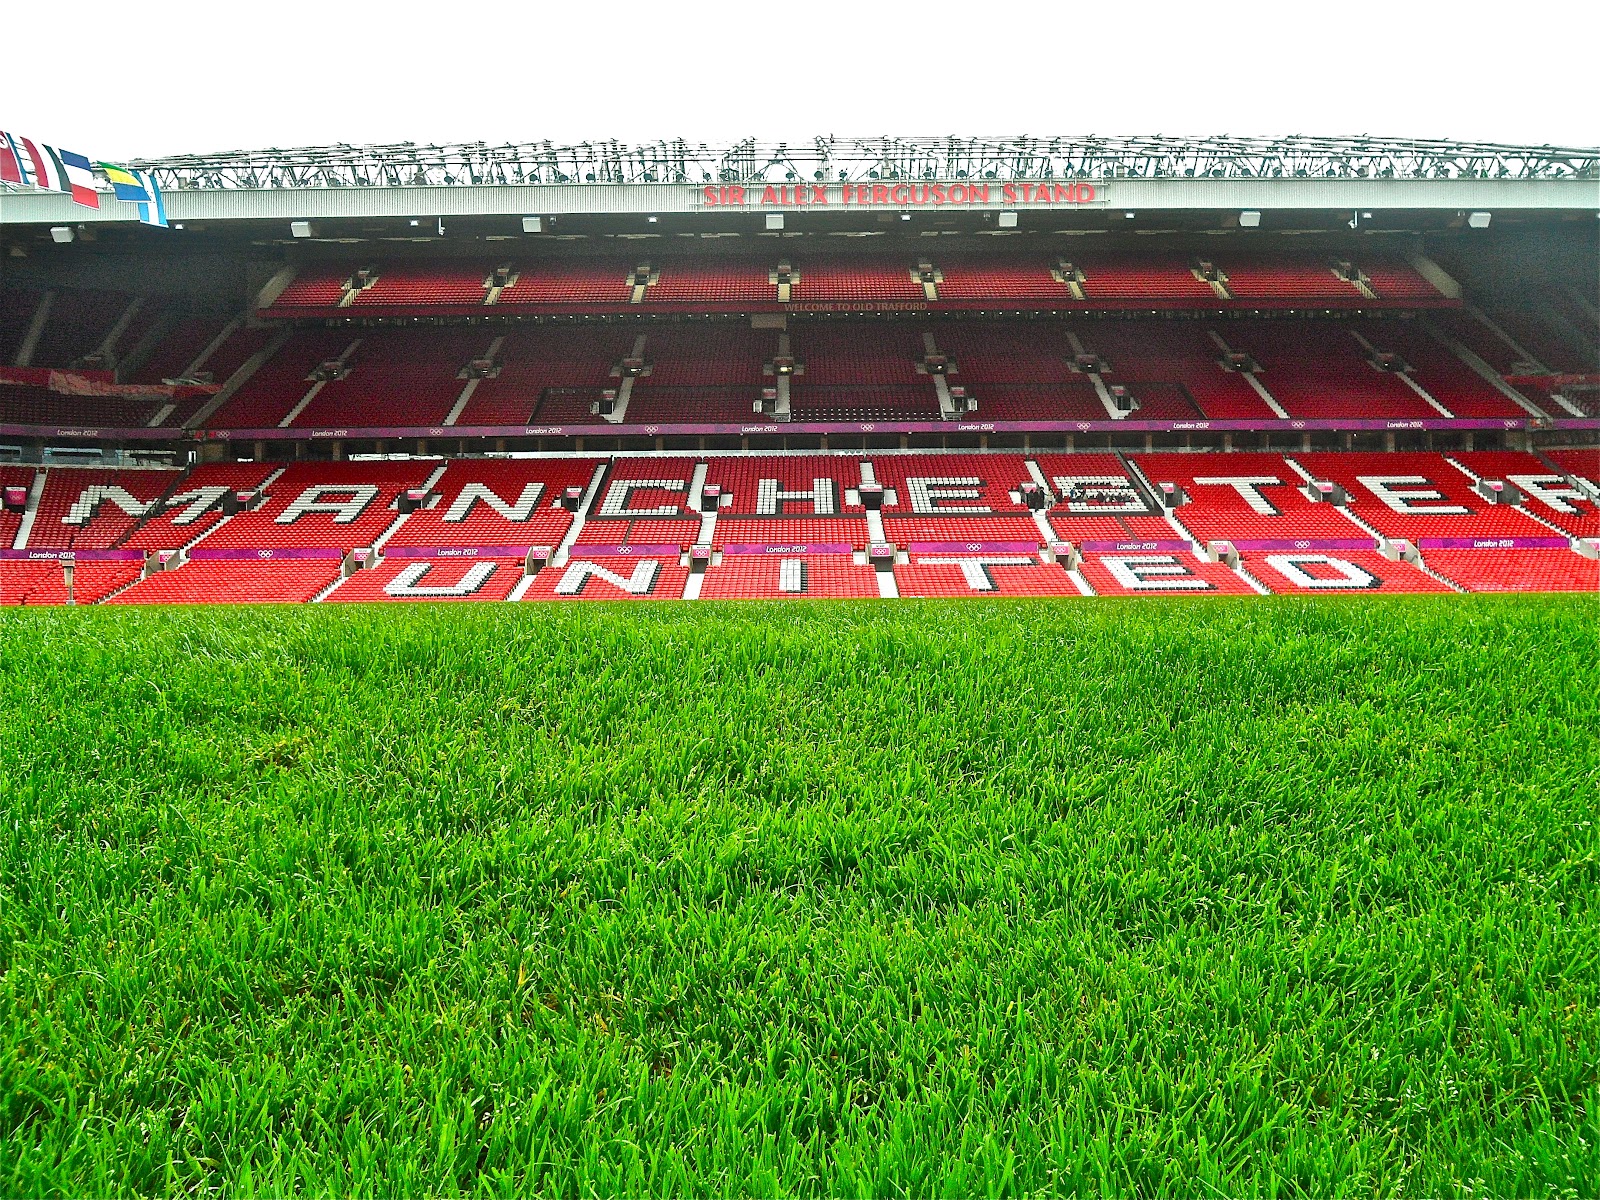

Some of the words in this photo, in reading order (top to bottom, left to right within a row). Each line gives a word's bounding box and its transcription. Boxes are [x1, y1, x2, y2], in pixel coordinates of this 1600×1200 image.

[703, 184, 745, 206] SIR
[760, 184, 828, 206] ALEX
[842, 183, 990, 205] FERGUSON
[1002, 183, 1095, 205] STAND
[784, 302, 834, 311] WELCOME
[835, 302, 850, 311] TO
[852, 302, 873, 311] OLD
[876, 302, 928, 311] TRAFFORD
[958, 423, 980, 431] London
[981, 423, 995, 431] 2012
[1173, 421, 1195, 429] London
[1196, 421, 1210, 429] 2012
[1387, 420, 1408, 428] London
[1409, 419, 1423, 428] 2012
[57, 429, 82, 437] London
[83, 429, 98, 437] 2012
[525, 427, 547, 435] London
[548, 427, 562, 435] 2012
[741, 425, 763, 433] London
[764, 425, 778, 433] 2012
[1474, 540, 1498, 548] London
[1498, 540, 1514, 548] 2012
[791, 545, 807, 553] 2012
[28, 551, 57, 559] London
[58, 551, 76, 559] 2012
[383, 554, 1384, 597] UNITED
